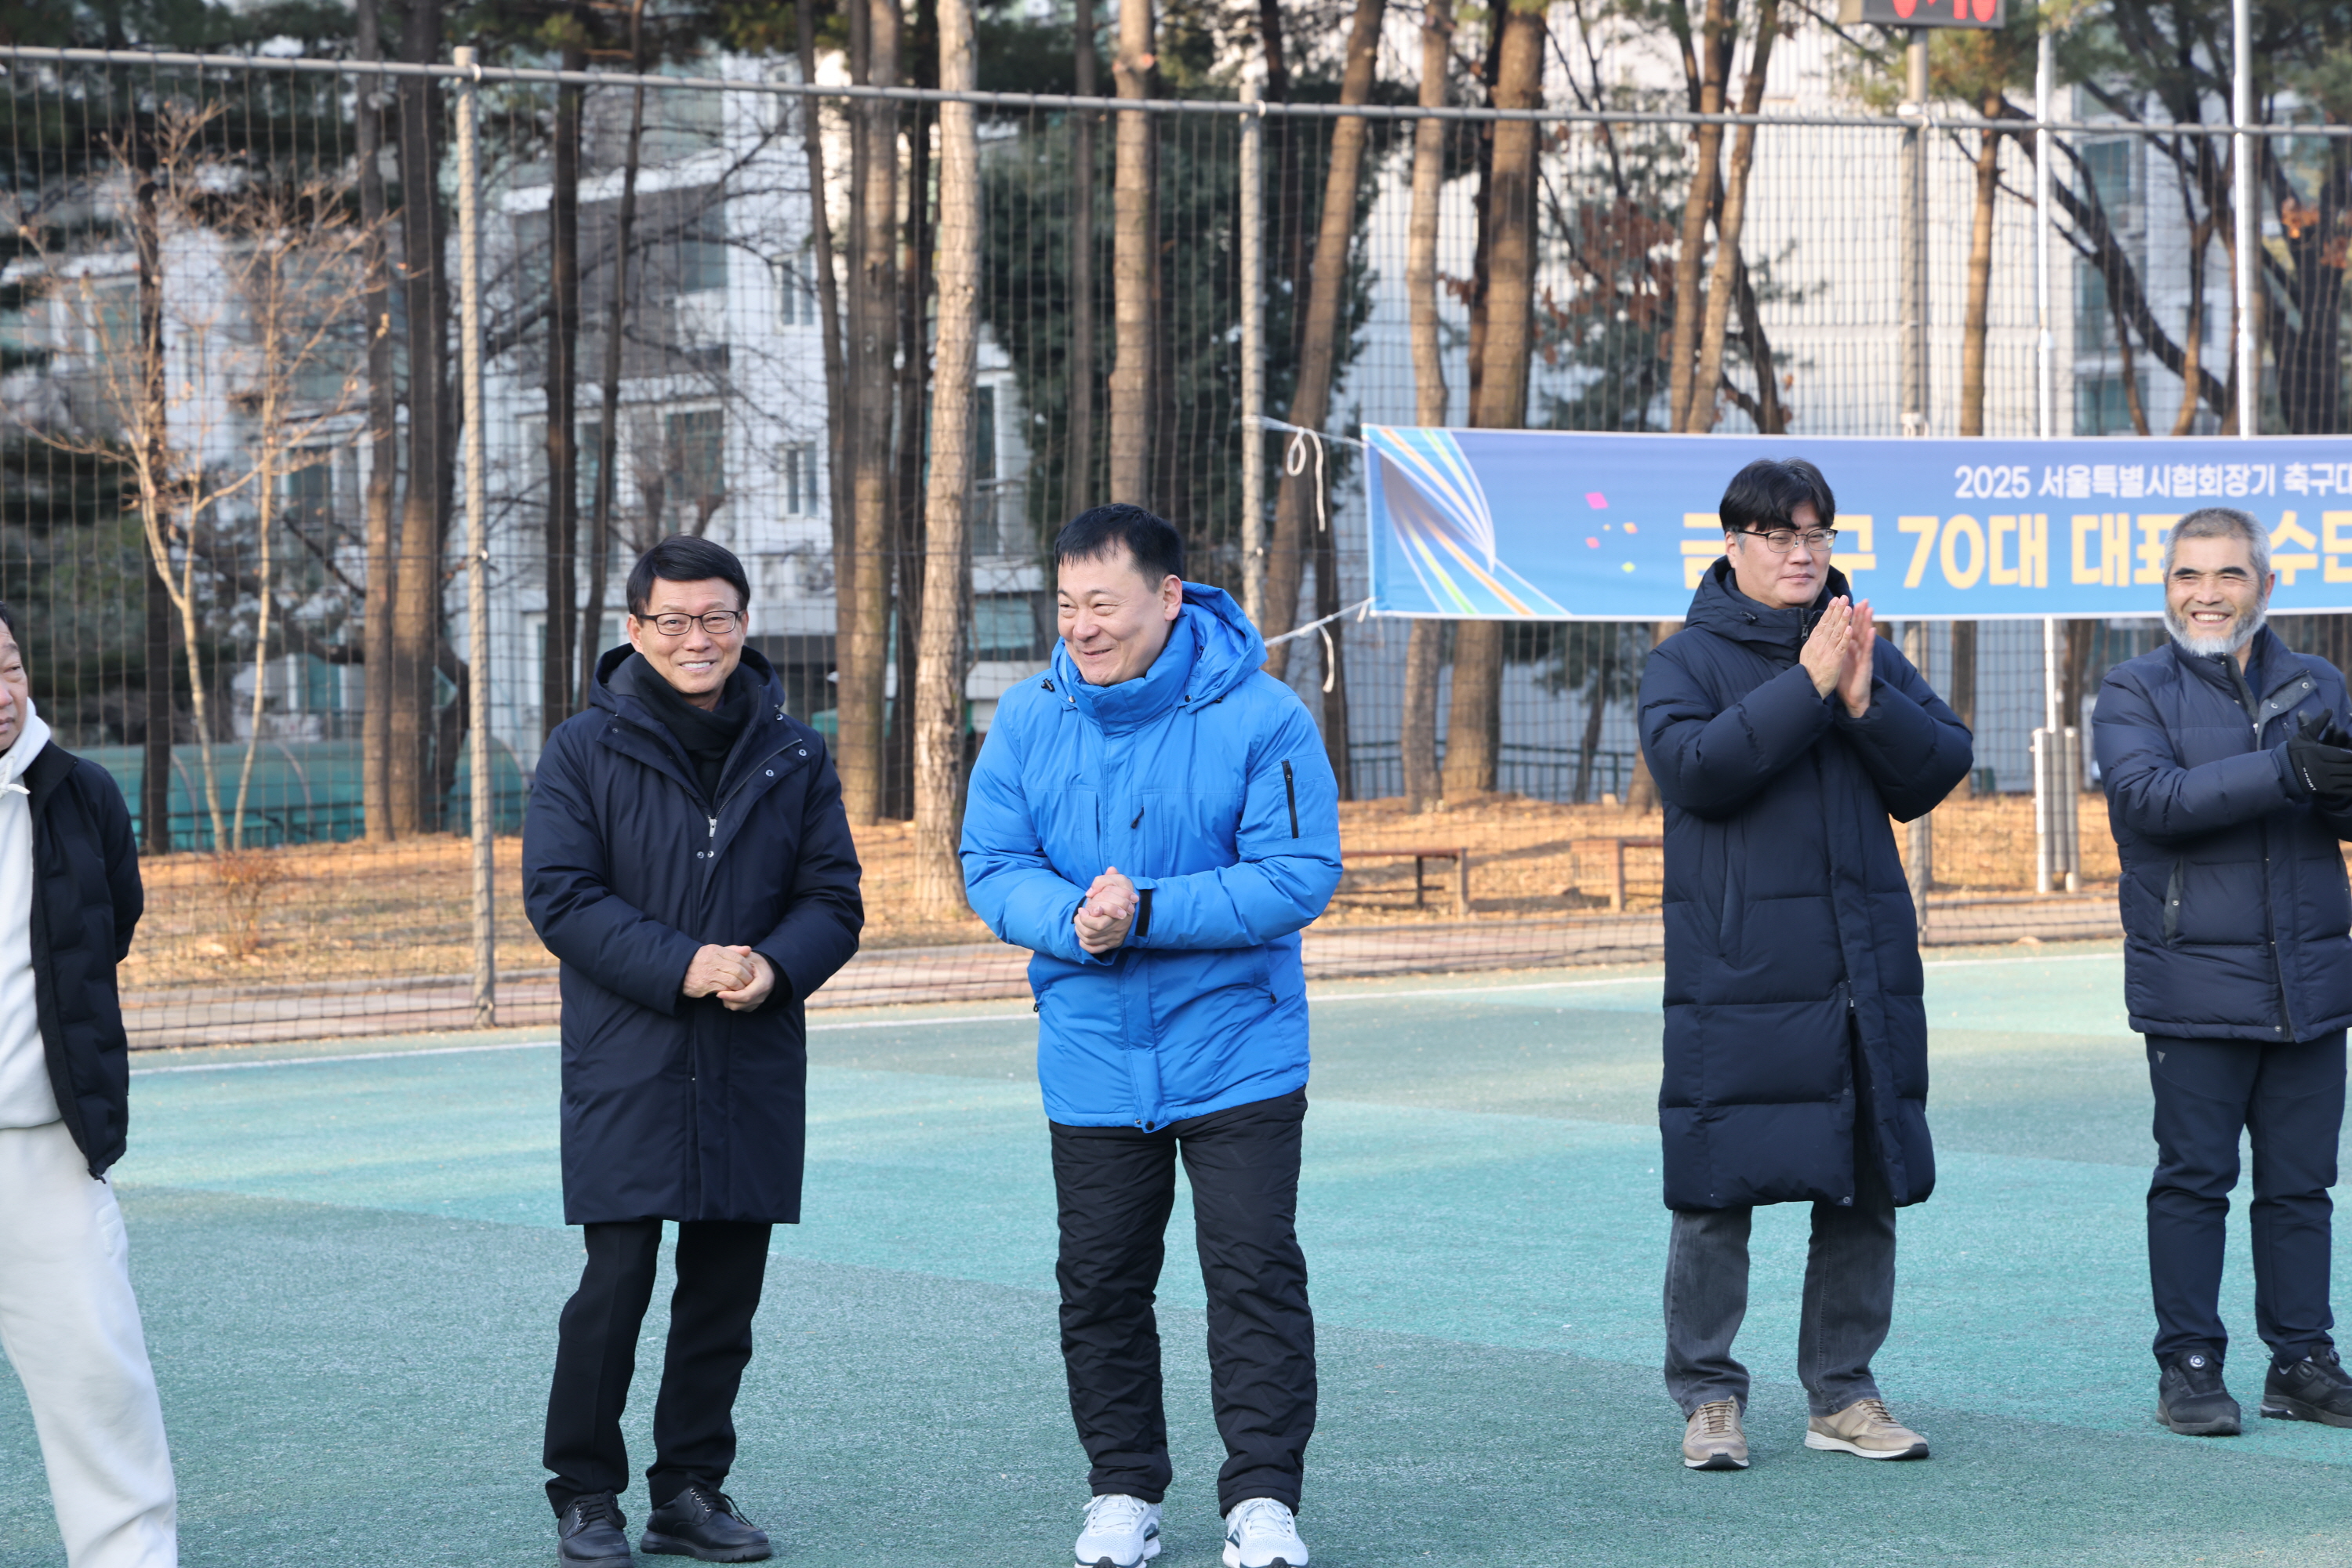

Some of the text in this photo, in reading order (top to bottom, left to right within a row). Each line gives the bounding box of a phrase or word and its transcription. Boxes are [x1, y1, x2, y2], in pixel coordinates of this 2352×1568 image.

[1955, 464, 2031, 499] 2025
[2038, 463, 2276, 499] 서울특별시협회장기
[1680, 512, 1877, 590] 금구
[1897, 513, 2049, 590] 70대
